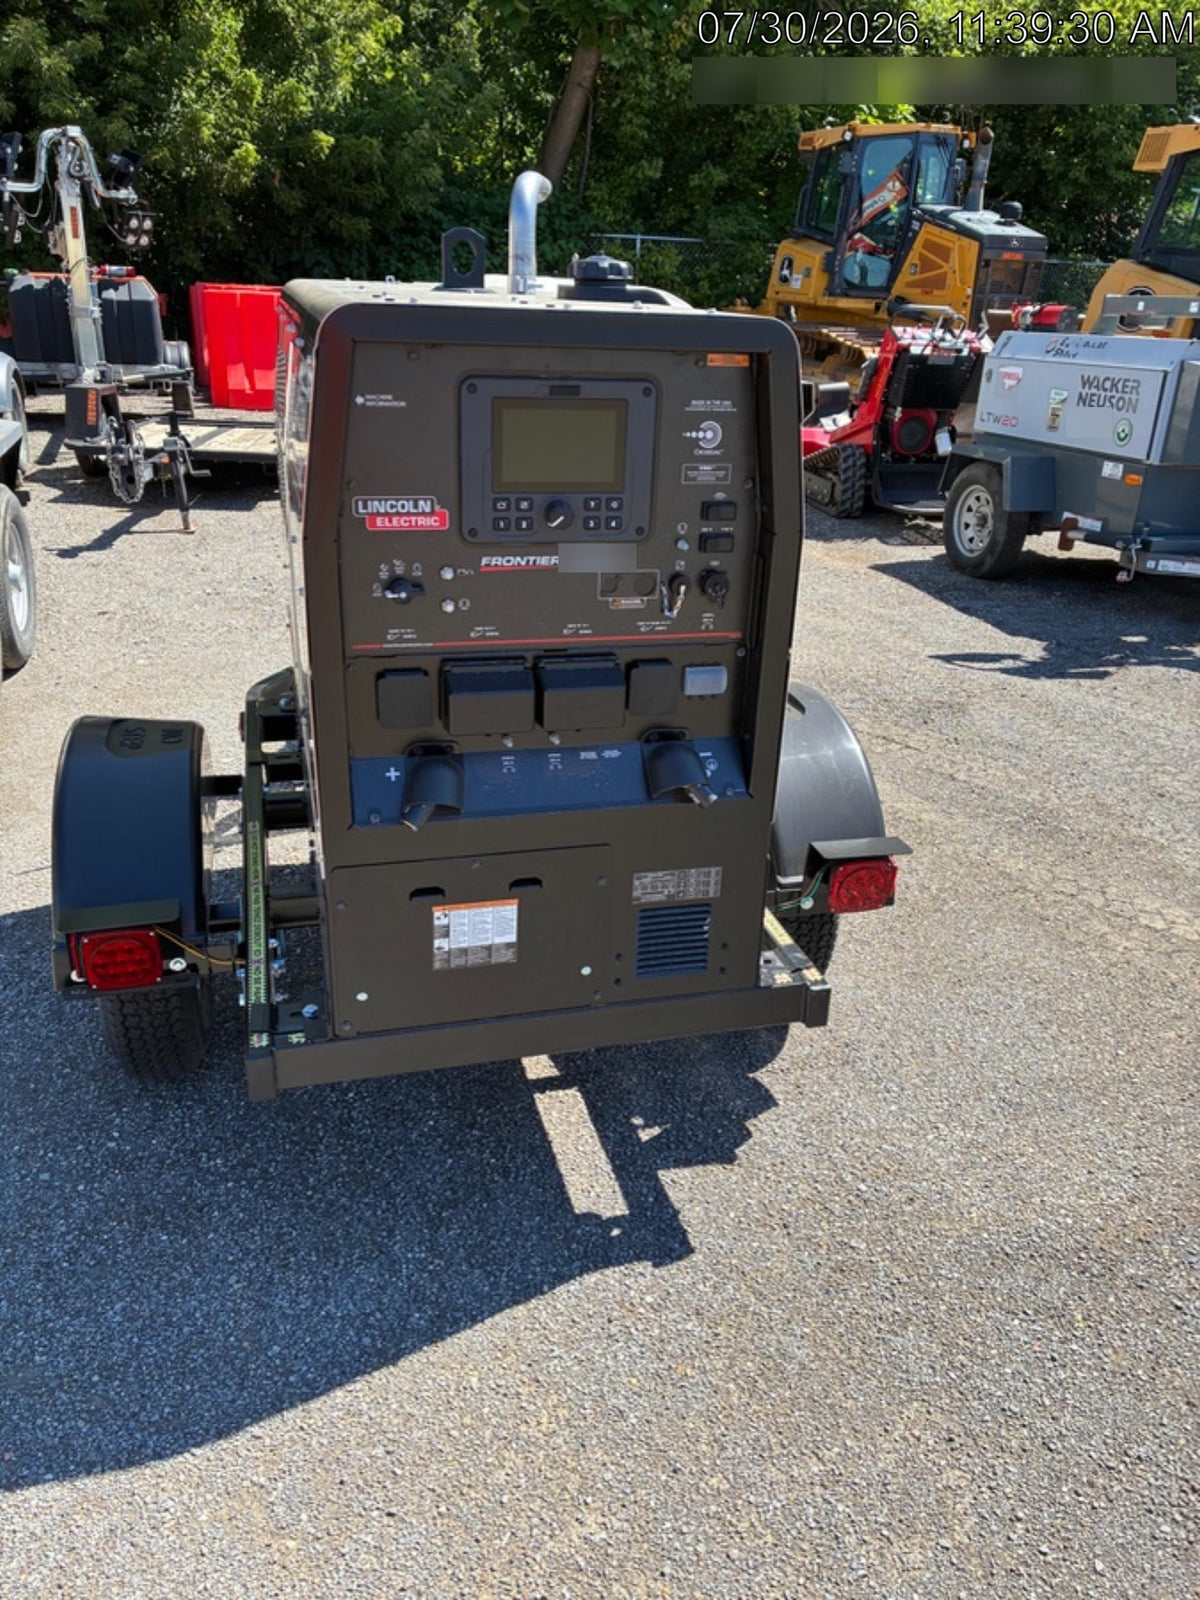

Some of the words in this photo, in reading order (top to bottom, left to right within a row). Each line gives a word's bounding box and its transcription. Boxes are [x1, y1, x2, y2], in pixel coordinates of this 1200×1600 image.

[1080, 374, 1141, 396] WACKER
[1076, 391, 1140, 414] NEUSON
[979, 410, 1019, 428] LTW20
[358, 500, 432, 513] LINCOLN
[376, 516, 440, 527] ELECTRIC
[480, 555, 559, 566] FRONTIER
